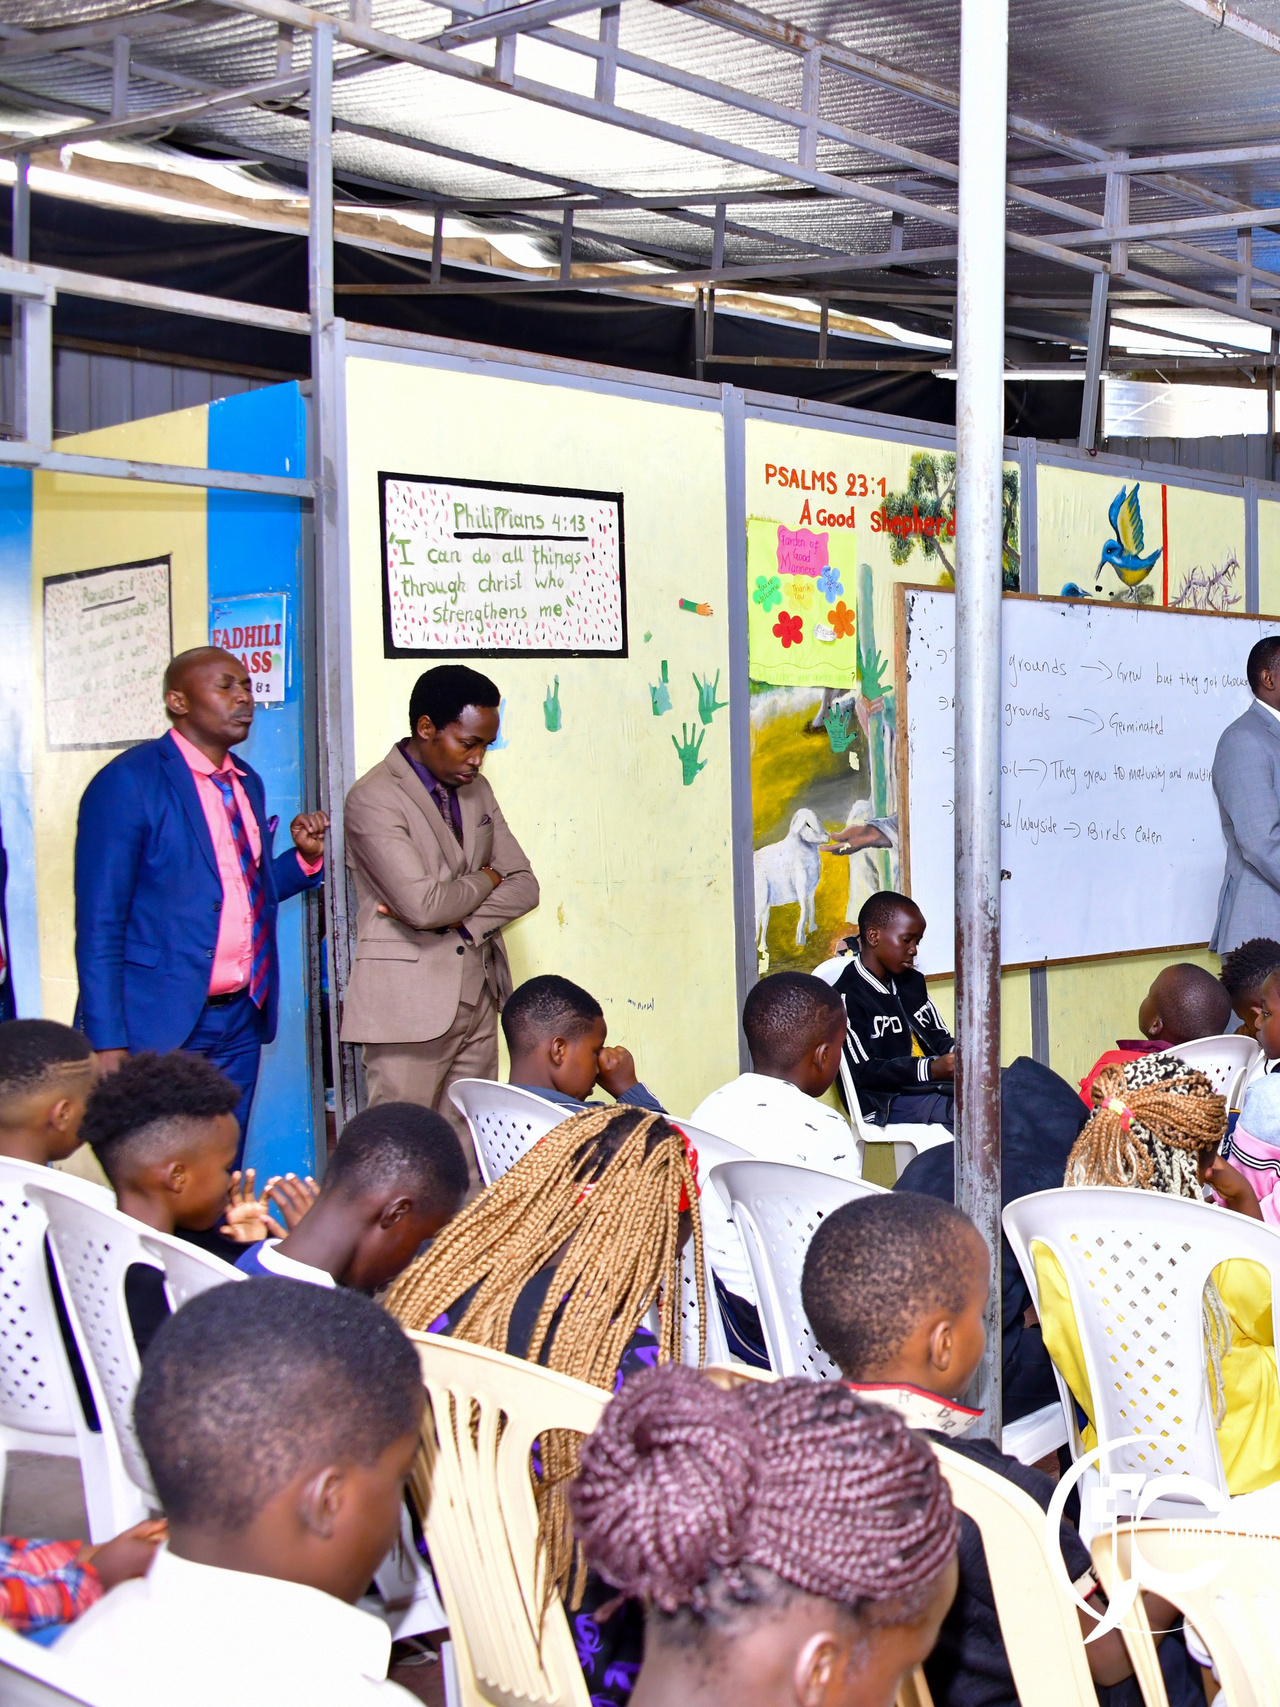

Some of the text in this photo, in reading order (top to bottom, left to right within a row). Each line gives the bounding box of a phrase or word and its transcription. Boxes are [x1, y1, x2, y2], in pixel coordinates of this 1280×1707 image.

[764, 462, 887, 498] PSALMS 23:1
[551, 512, 587, 533] 4:13
[799, 498, 811, 526] A
[816, 506, 855, 529] Good
[778, 528, 820, 555] Garden of
[793, 549, 811, 563] Good
[427, 548, 462, 564] can
[472, 547, 491, 564] do
[502, 545, 524, 564] all
[532, 544, 582, 574] things
[780, 552, 816, 575] Manners
[401, 569, 564, 605] through christ who
[432, 601, 528, 635] strengthens
[212, 623, 282, 650] FADHILI
[238, 650, 273, 674] ASS
[1008, 654, 1067, 687] grounds
[1156, 662, 1173, 685] but
[1179, 667, 1199, 694] they
[1203, 675, 1217, 694] got
[1005, 703, 1164, 737] grounds Germinated
[1000, 761, 1018, 779] oil
[1050, 759, 1077, 794] They
[1083, 767, 1107, 790] grew
[1169, 767, 1182, 780] and
[1087, 819, 1126, 841] Birds
